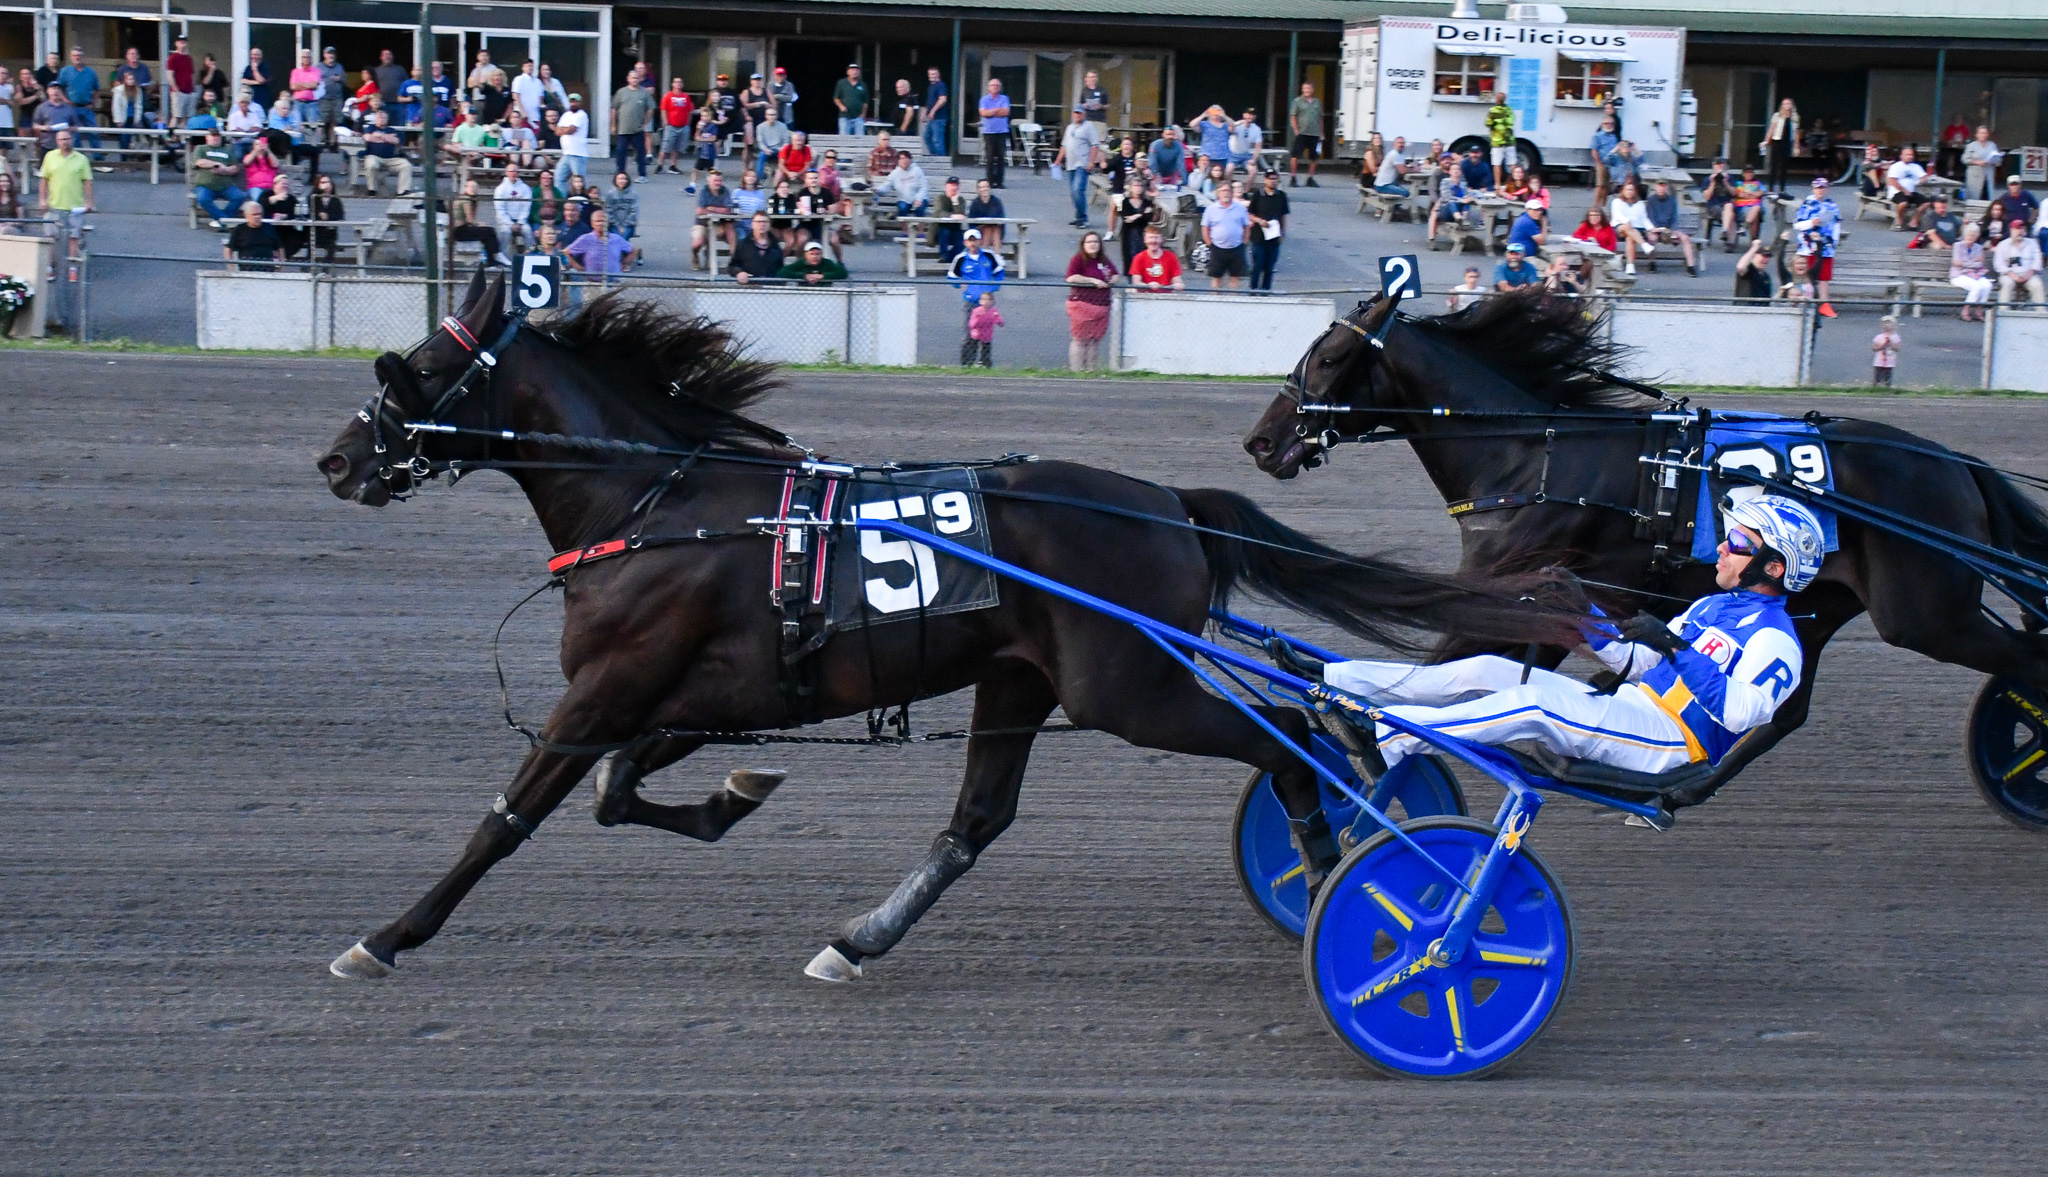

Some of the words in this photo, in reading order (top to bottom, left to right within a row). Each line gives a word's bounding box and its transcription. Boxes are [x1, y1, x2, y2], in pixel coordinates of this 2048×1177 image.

[1437, 25, 1626, 46] Deli-licious
[1386, 68, 1426, 78] ORDER
[1390, 81, 1420, 90] HERE
[519, 256, 551, 308] 5
[1385, 257, 1414, 298] 2
[1790, 444, 1825, 483] 9
[931, 491, 973, 534] 9
[851, 495, 940, 613] 5
[1750, 657, 1794, 705] R
[1369, 966, 1412, 1001] LZR
